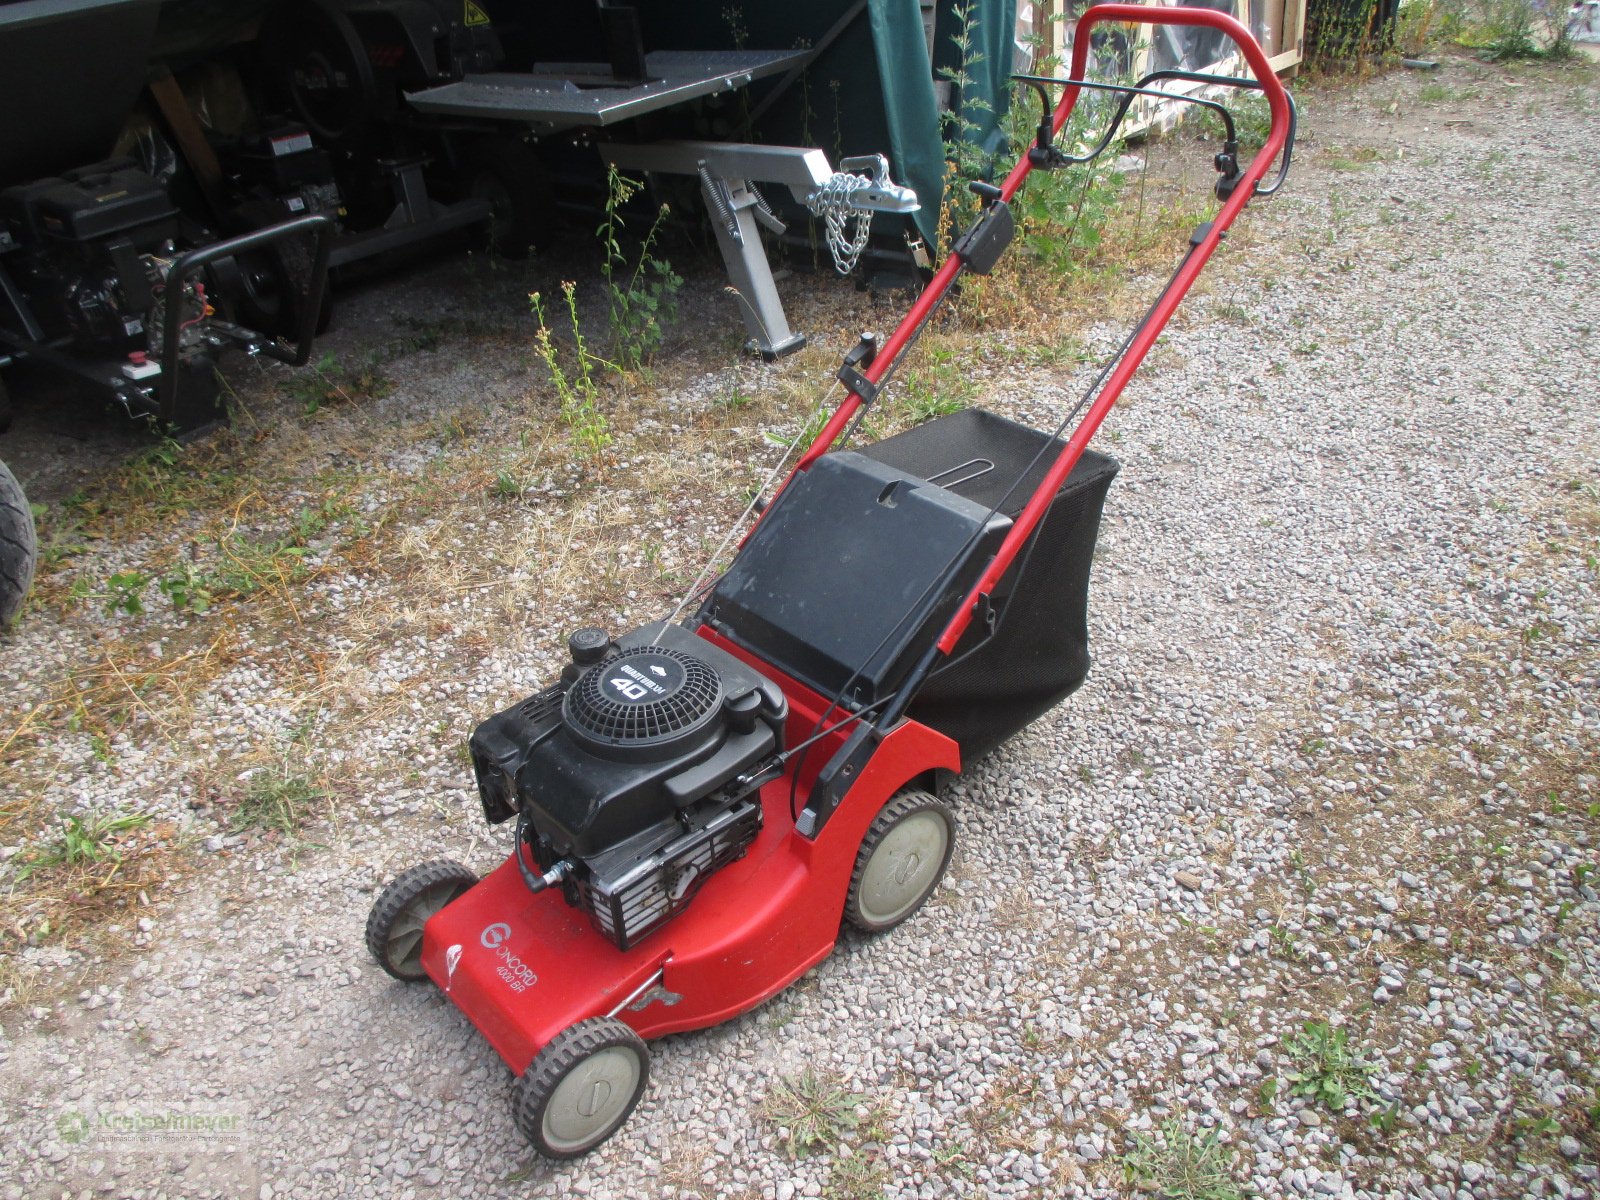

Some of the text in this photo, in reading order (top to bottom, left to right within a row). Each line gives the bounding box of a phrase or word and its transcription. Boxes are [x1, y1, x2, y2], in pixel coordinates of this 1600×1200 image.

[610, 678, 648, 700] 40
[620, 664, 657, 690] QUANTUM
[480, 922, 538, 987] CONCORD
[496, 965, 526, 994] 4000 BR
